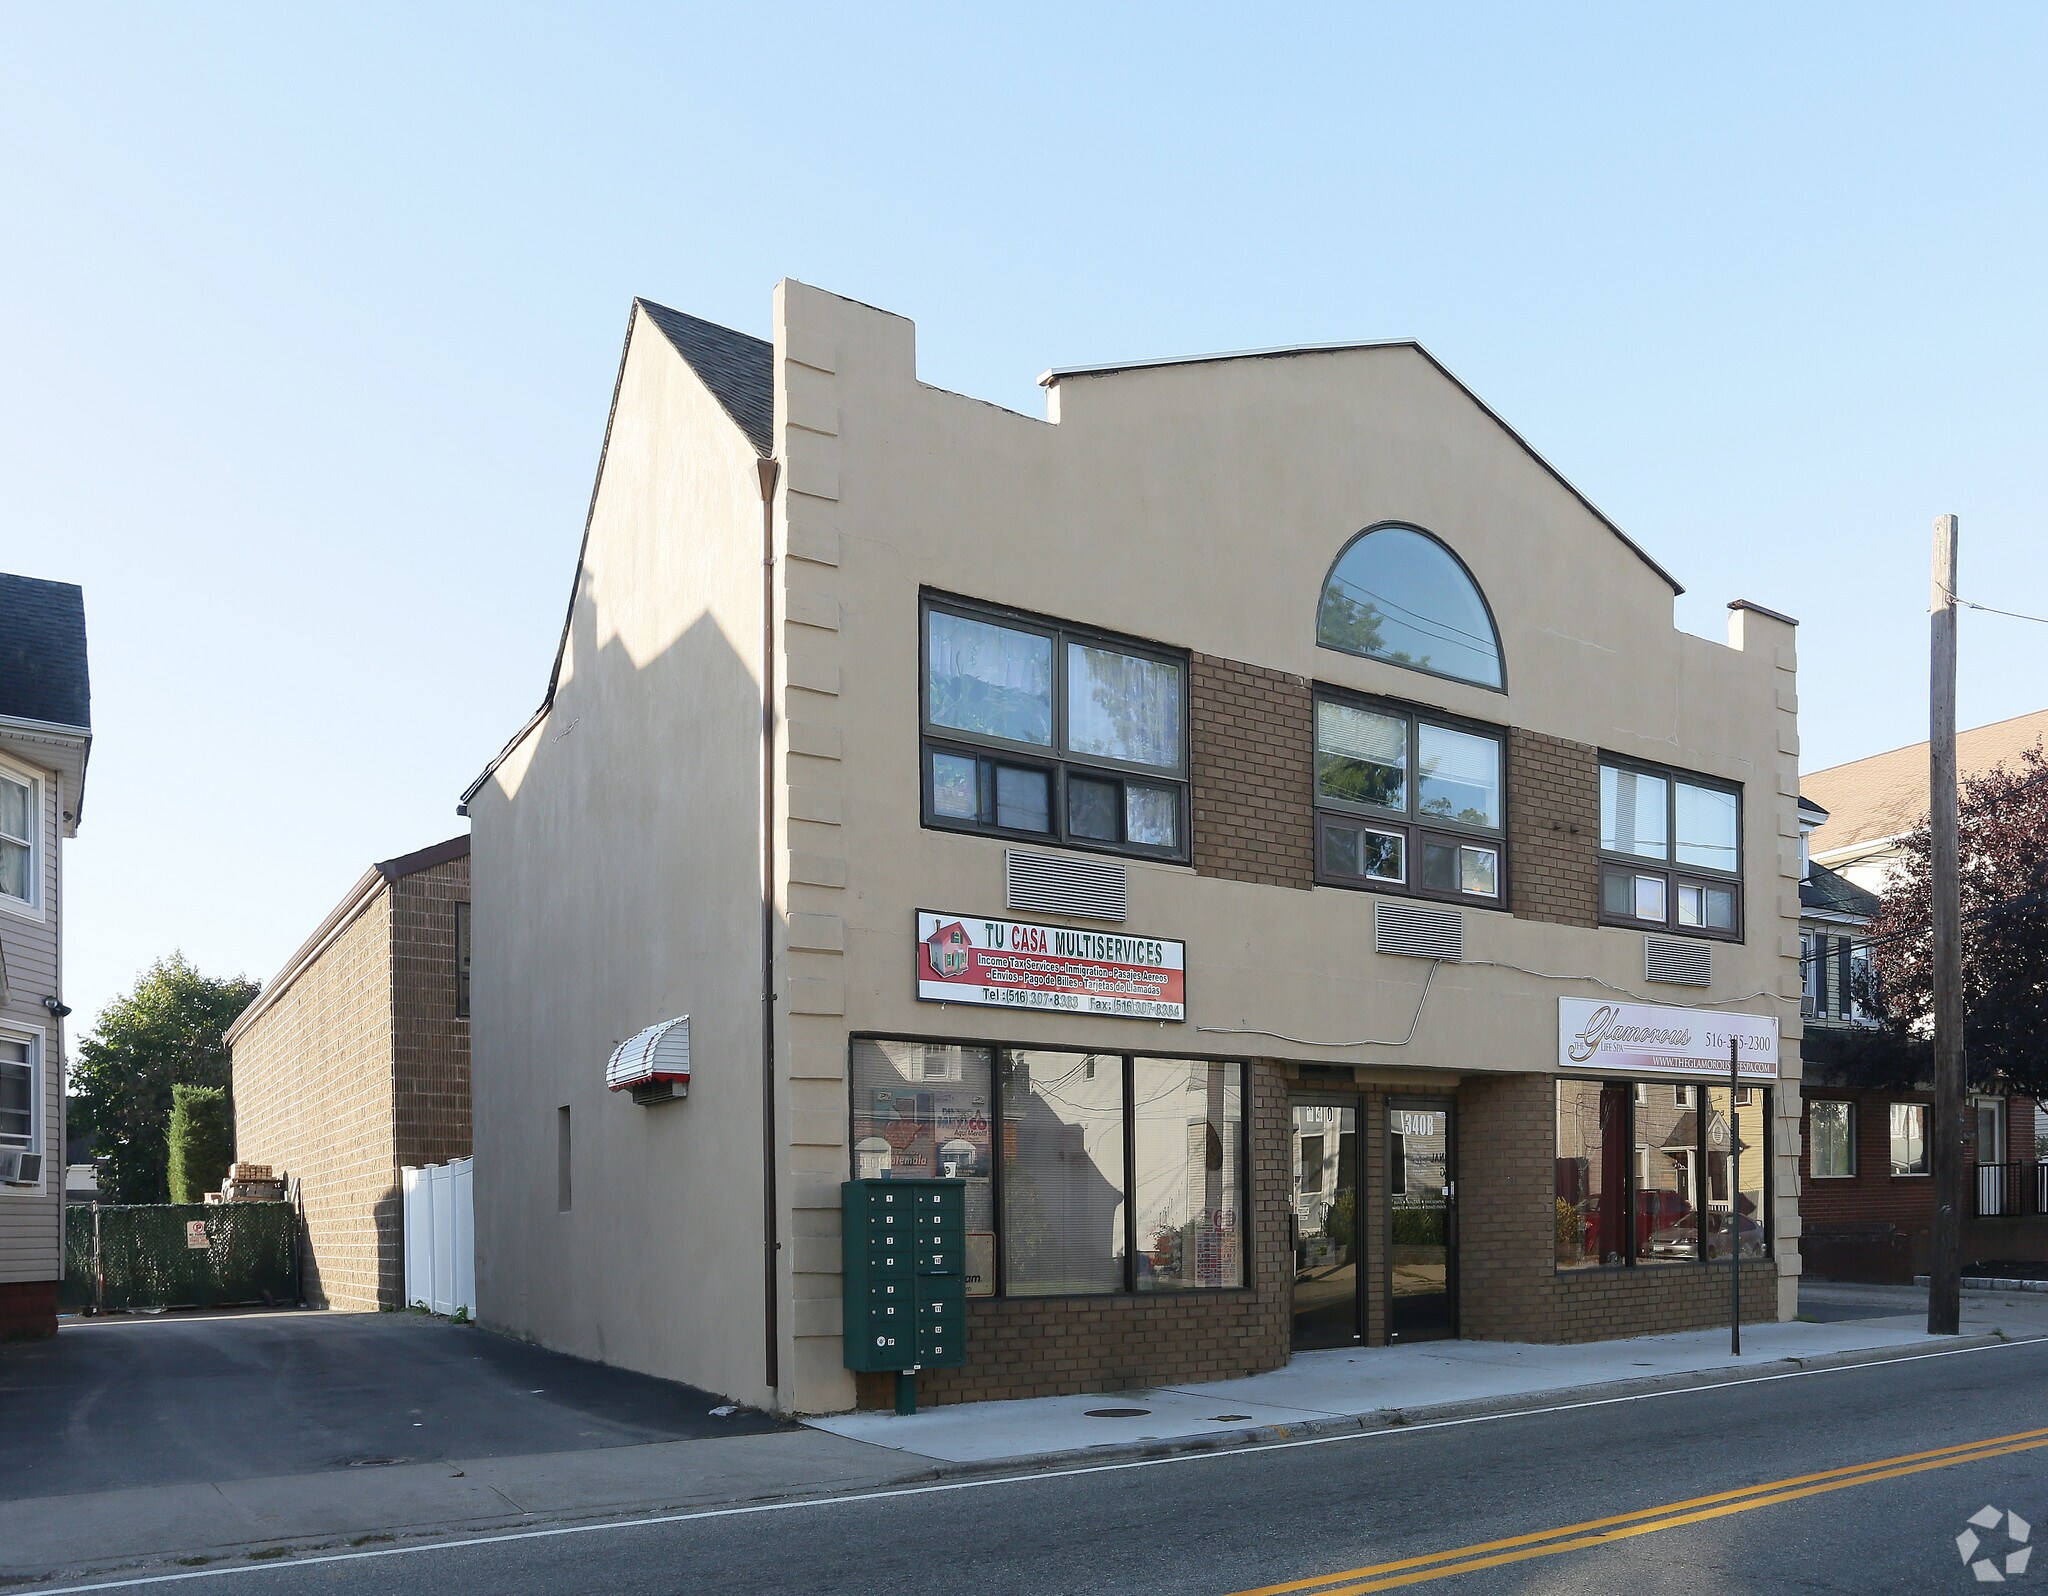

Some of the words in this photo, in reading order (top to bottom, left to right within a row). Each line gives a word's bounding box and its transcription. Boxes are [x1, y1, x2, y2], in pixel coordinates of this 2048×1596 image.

[985, 923, 1004, 949] TU
[1011, 926, 1047, 954] CASA
[1055, 931, 1162, 966] MULTISERVICES
[978, 954, 1008, 967] Income
[1010, 957, 1025, 969] Tax
[1026, 959, 1059, 972] Services
[1065, 962, 1108, 977] Inmigration
[1114, 968, 1141, 982] Pasajes
[1143, 971, 1167, 983] Aereos
[992, 969, 1018, 981] Envios
[1024, 972, 1044, 985] Pago
[1045, 975, 1055, 985] de
[1057, 976, 1078, 987] Billes
[1083, 978, 1114, 992] Tarjetas
[1115, 982, 1125, 992] de
[1126, 983, 1160, 995] Llamadas
[1568, 1005, 1692, 1062] Glamorous
[1574, 1042, 1585, 1050] THE
[1405, 1113, 1434, 1136] 340B
